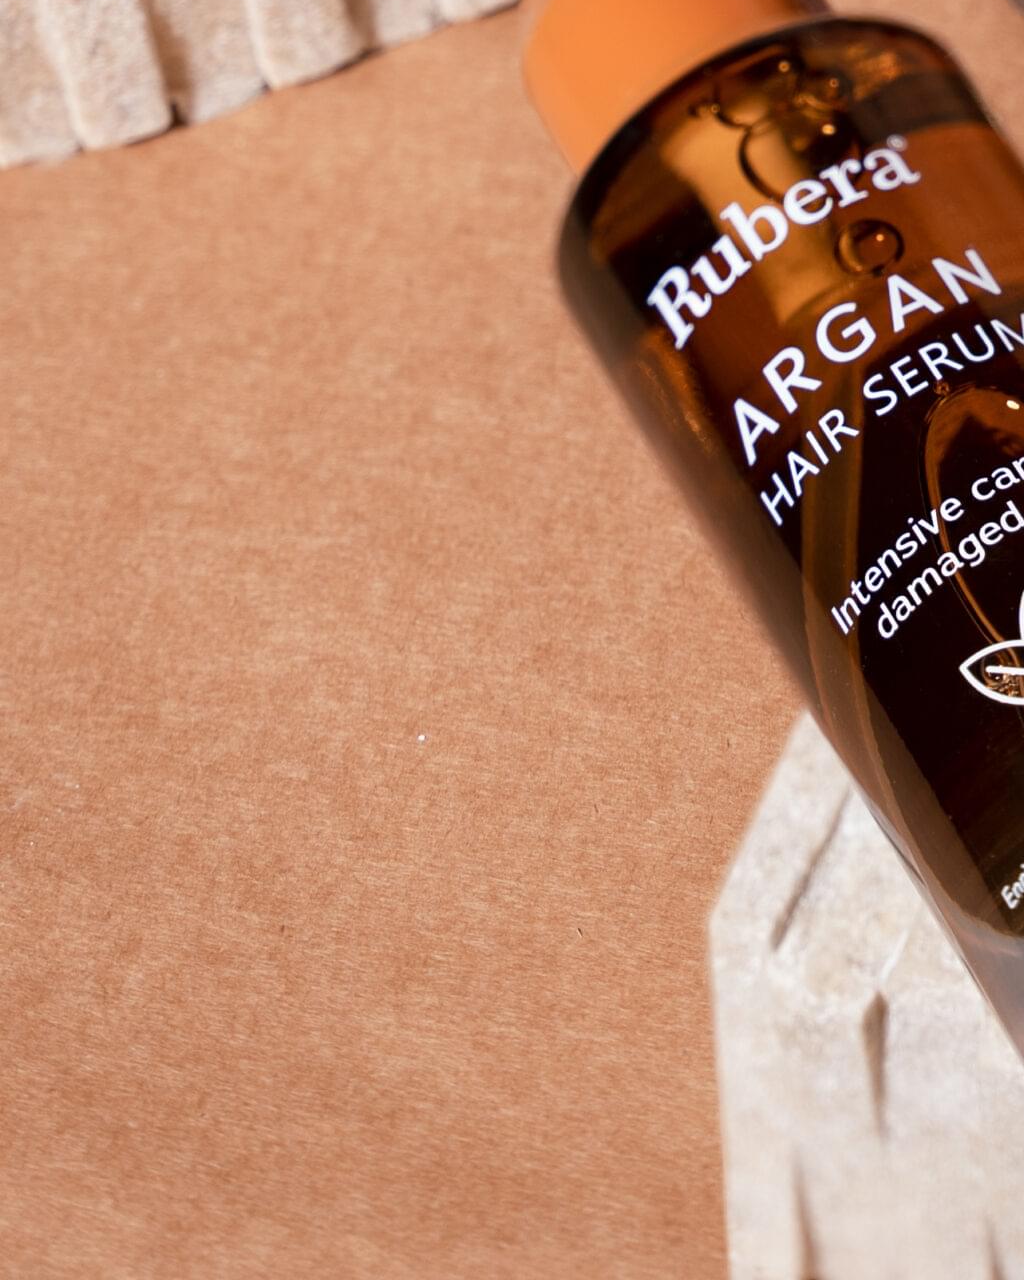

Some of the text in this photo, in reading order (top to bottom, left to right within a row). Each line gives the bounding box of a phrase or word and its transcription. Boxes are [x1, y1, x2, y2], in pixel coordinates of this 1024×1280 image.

[731, 249, 1004, 466] ARGAN
[760, 408, 860, 527] HAIR
[831, 497, 963, 634] Intensive
